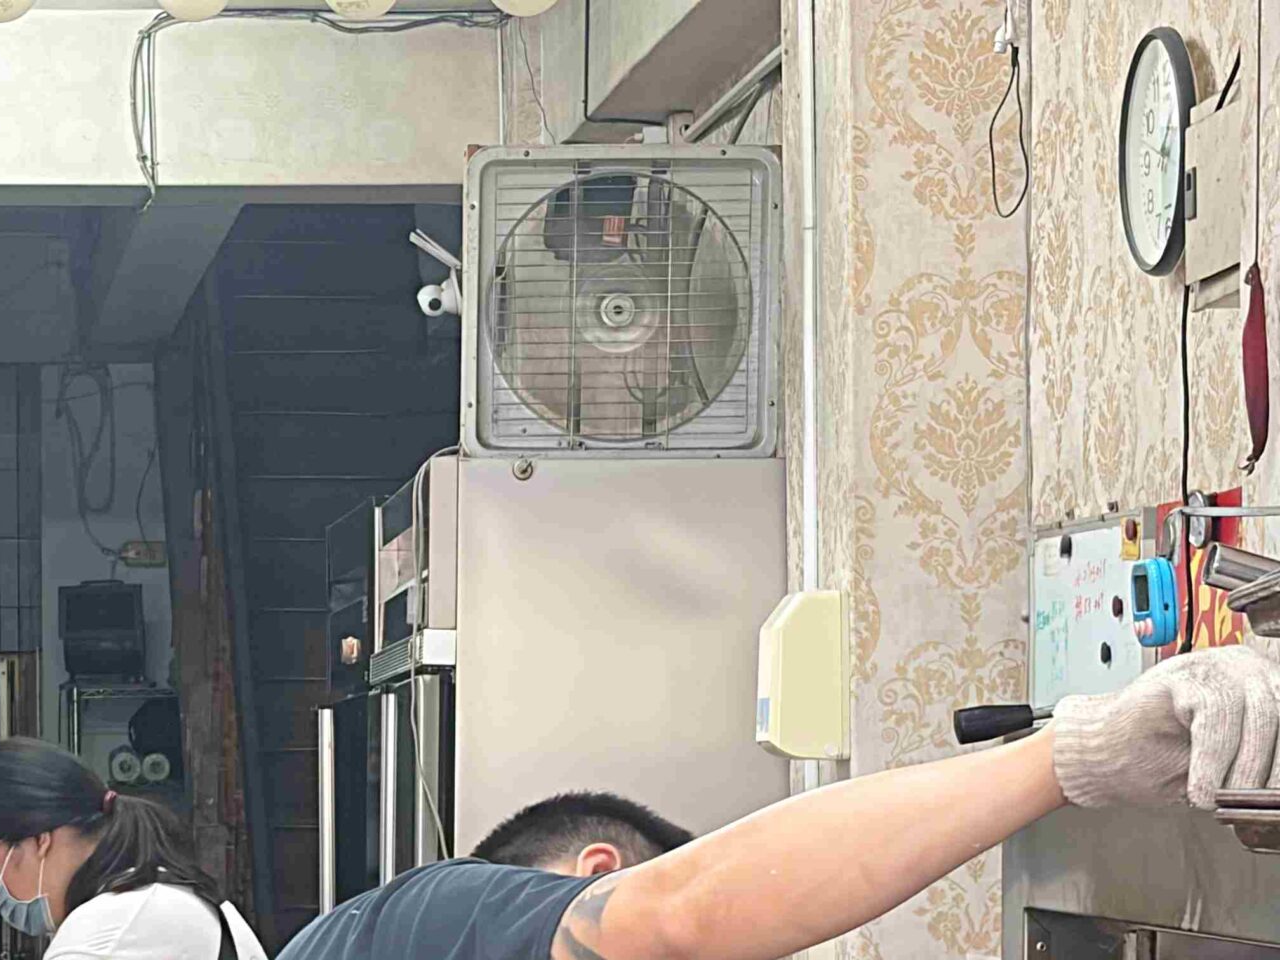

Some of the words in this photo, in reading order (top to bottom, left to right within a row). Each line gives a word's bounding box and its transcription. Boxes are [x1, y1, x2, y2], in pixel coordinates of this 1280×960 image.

[1145, 108, 1155, 137] 10
[1143, 151, 1151, 177] 9
[1146, 188, 1154, 214] 8
[1154, 212, 1162, 241] 7
